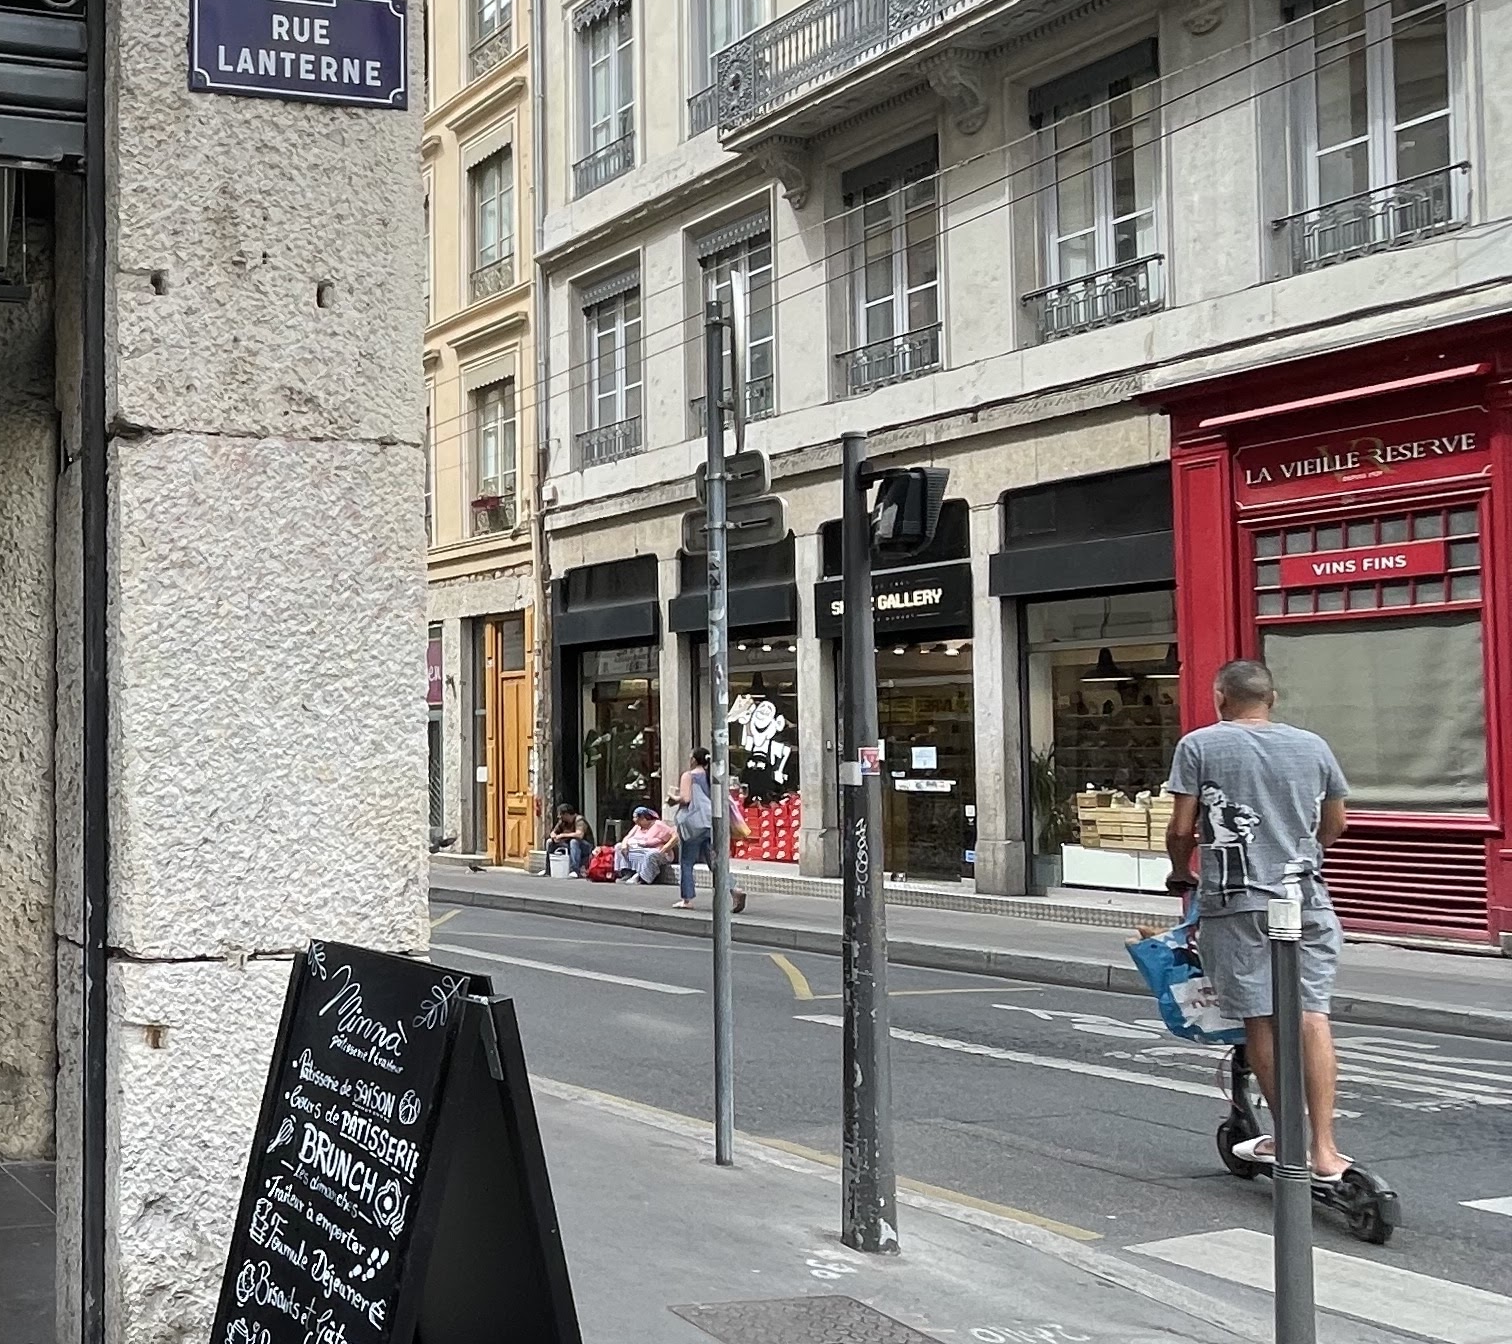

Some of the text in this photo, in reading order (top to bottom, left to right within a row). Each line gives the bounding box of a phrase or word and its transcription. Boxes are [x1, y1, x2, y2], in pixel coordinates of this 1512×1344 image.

[272, 14, 330, 45] RUE
[218, 45, 382, 87] LANTERNE
[1246, 468, 1272, 485] LA
[1280, 451, 1360, 478] VIEILLE
[1312, 554, 1407, 576] VINS FINS
[878, 587, 943, 610] GALLERY
[339, 1078, 352, 1098] de
[324, 1104, 340, 1126] de
[298, 1122, 378, 1203] BRUNCH
[268, 1175, 366, 1256] Traiteur à emporter
[255, 1260, 300, 1320] Biscuits
[300, 1296, 317, 1331] et
[311, 1249, 370, 1312] Déjeuner
